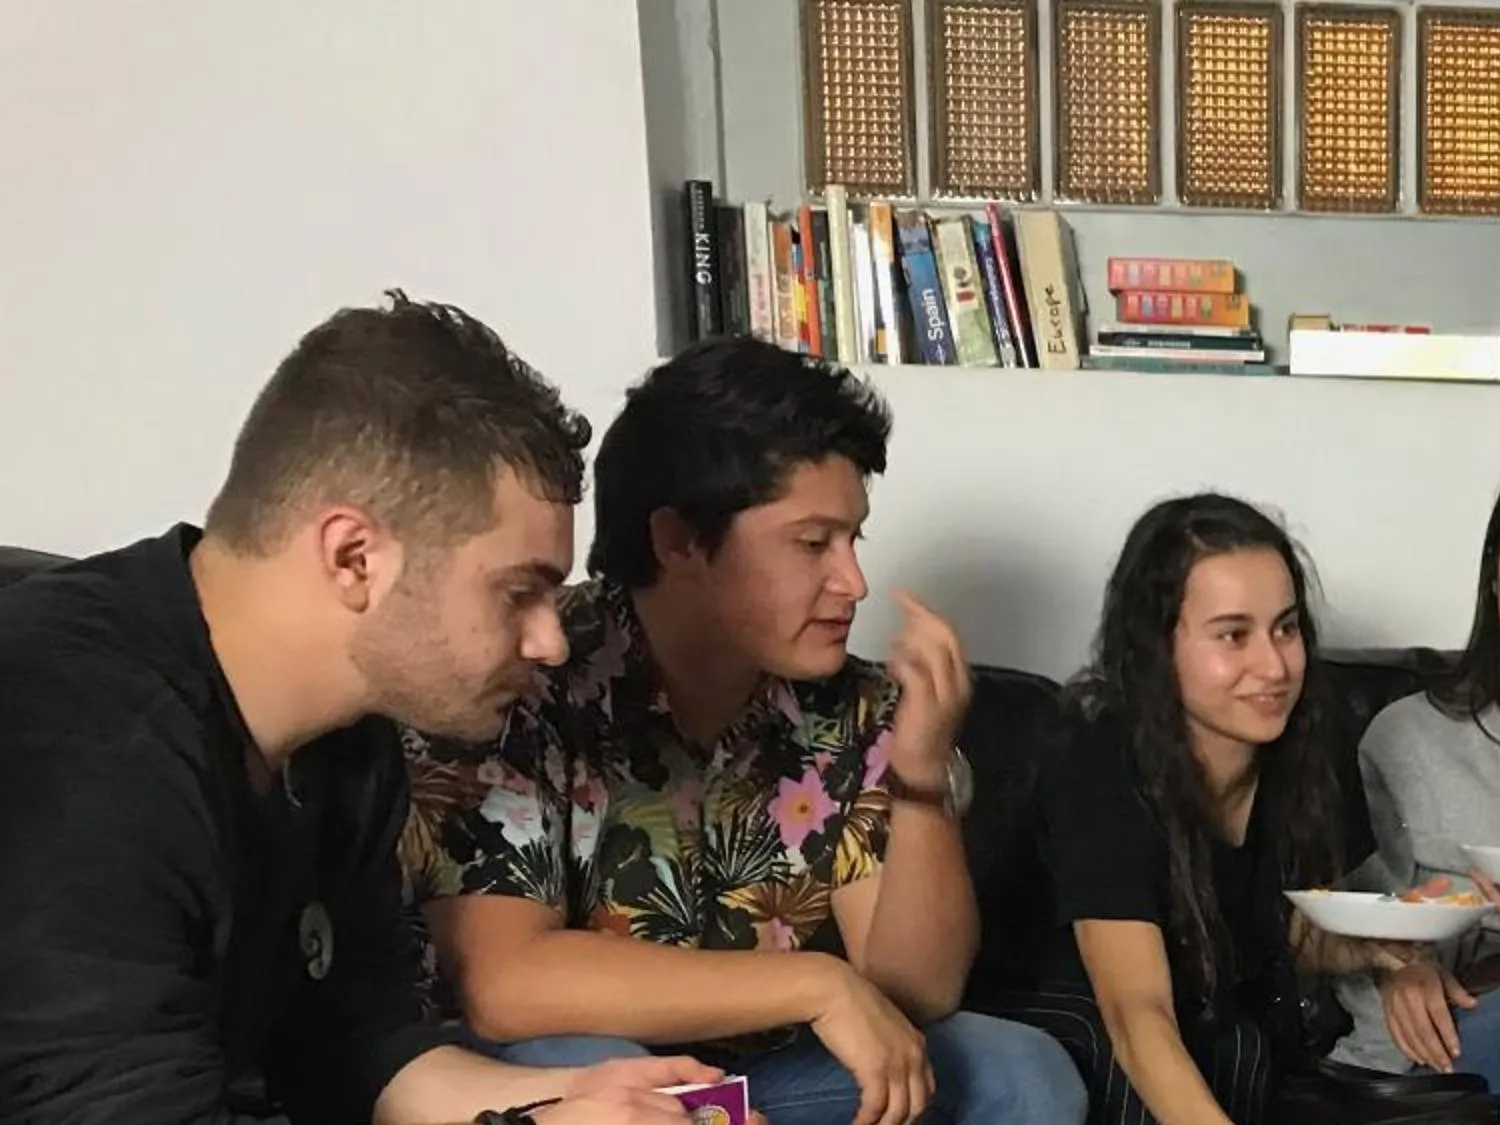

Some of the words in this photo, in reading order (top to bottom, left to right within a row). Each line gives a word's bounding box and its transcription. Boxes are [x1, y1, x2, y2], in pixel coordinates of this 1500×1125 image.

[695, 232, 712, 285] KING
[922, 289, 946, 341] Spain
[1045, 287, 1067, 353] Europe
